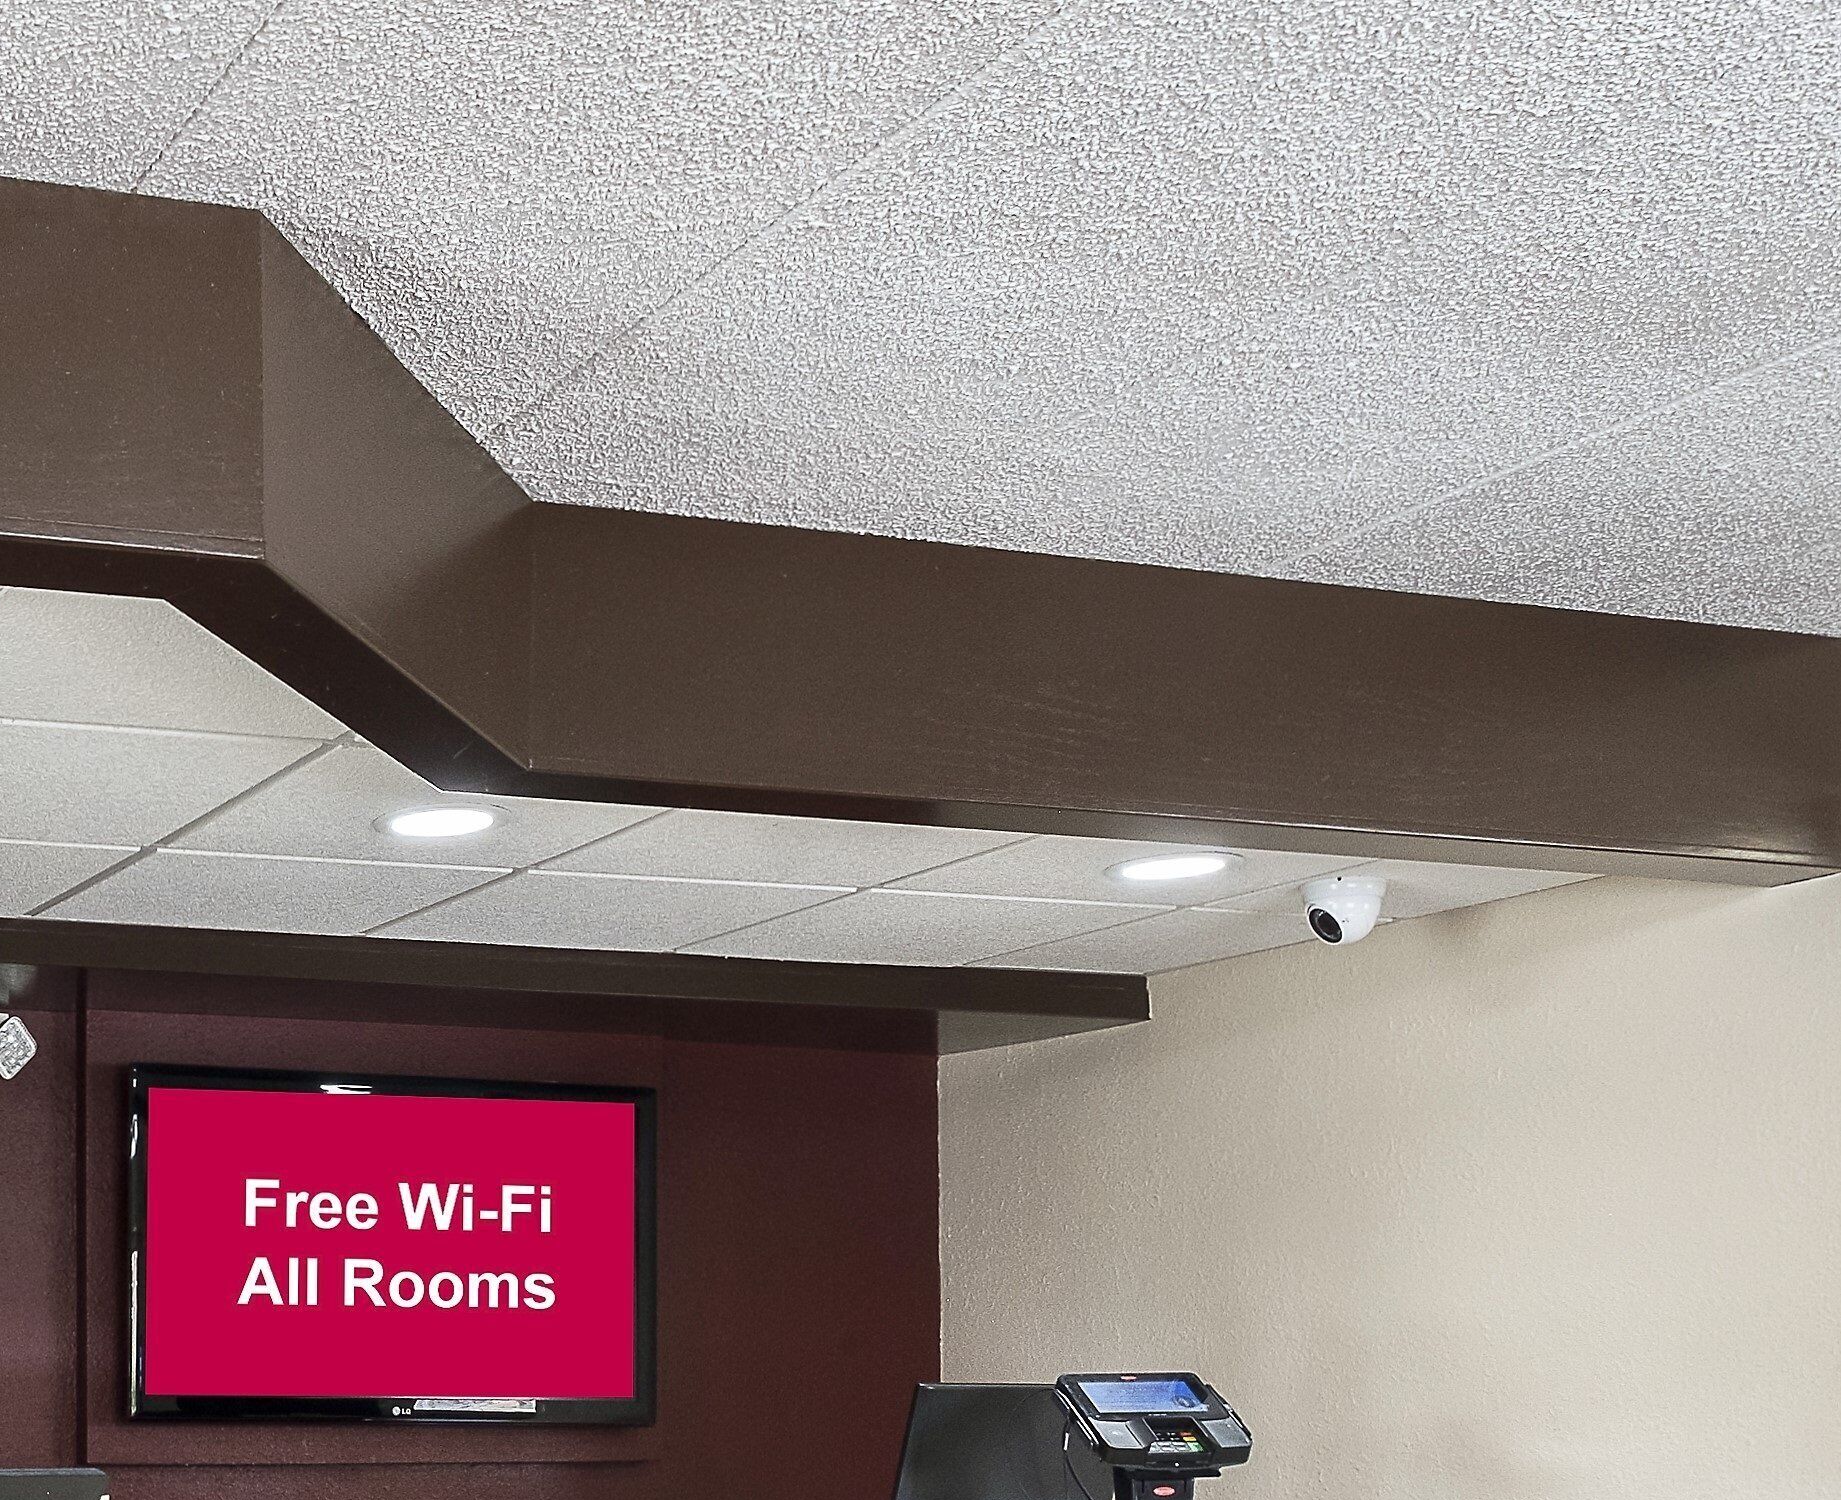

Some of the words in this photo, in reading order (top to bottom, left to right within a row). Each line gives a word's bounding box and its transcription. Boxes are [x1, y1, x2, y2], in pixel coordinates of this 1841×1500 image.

[245, 1178, 379, 1230] Free
[398, 1182, 552, 1233] Wi-Fi
[237, 1257, 318, 1306] All
[343, 1258, 556, 1310] Rooms
